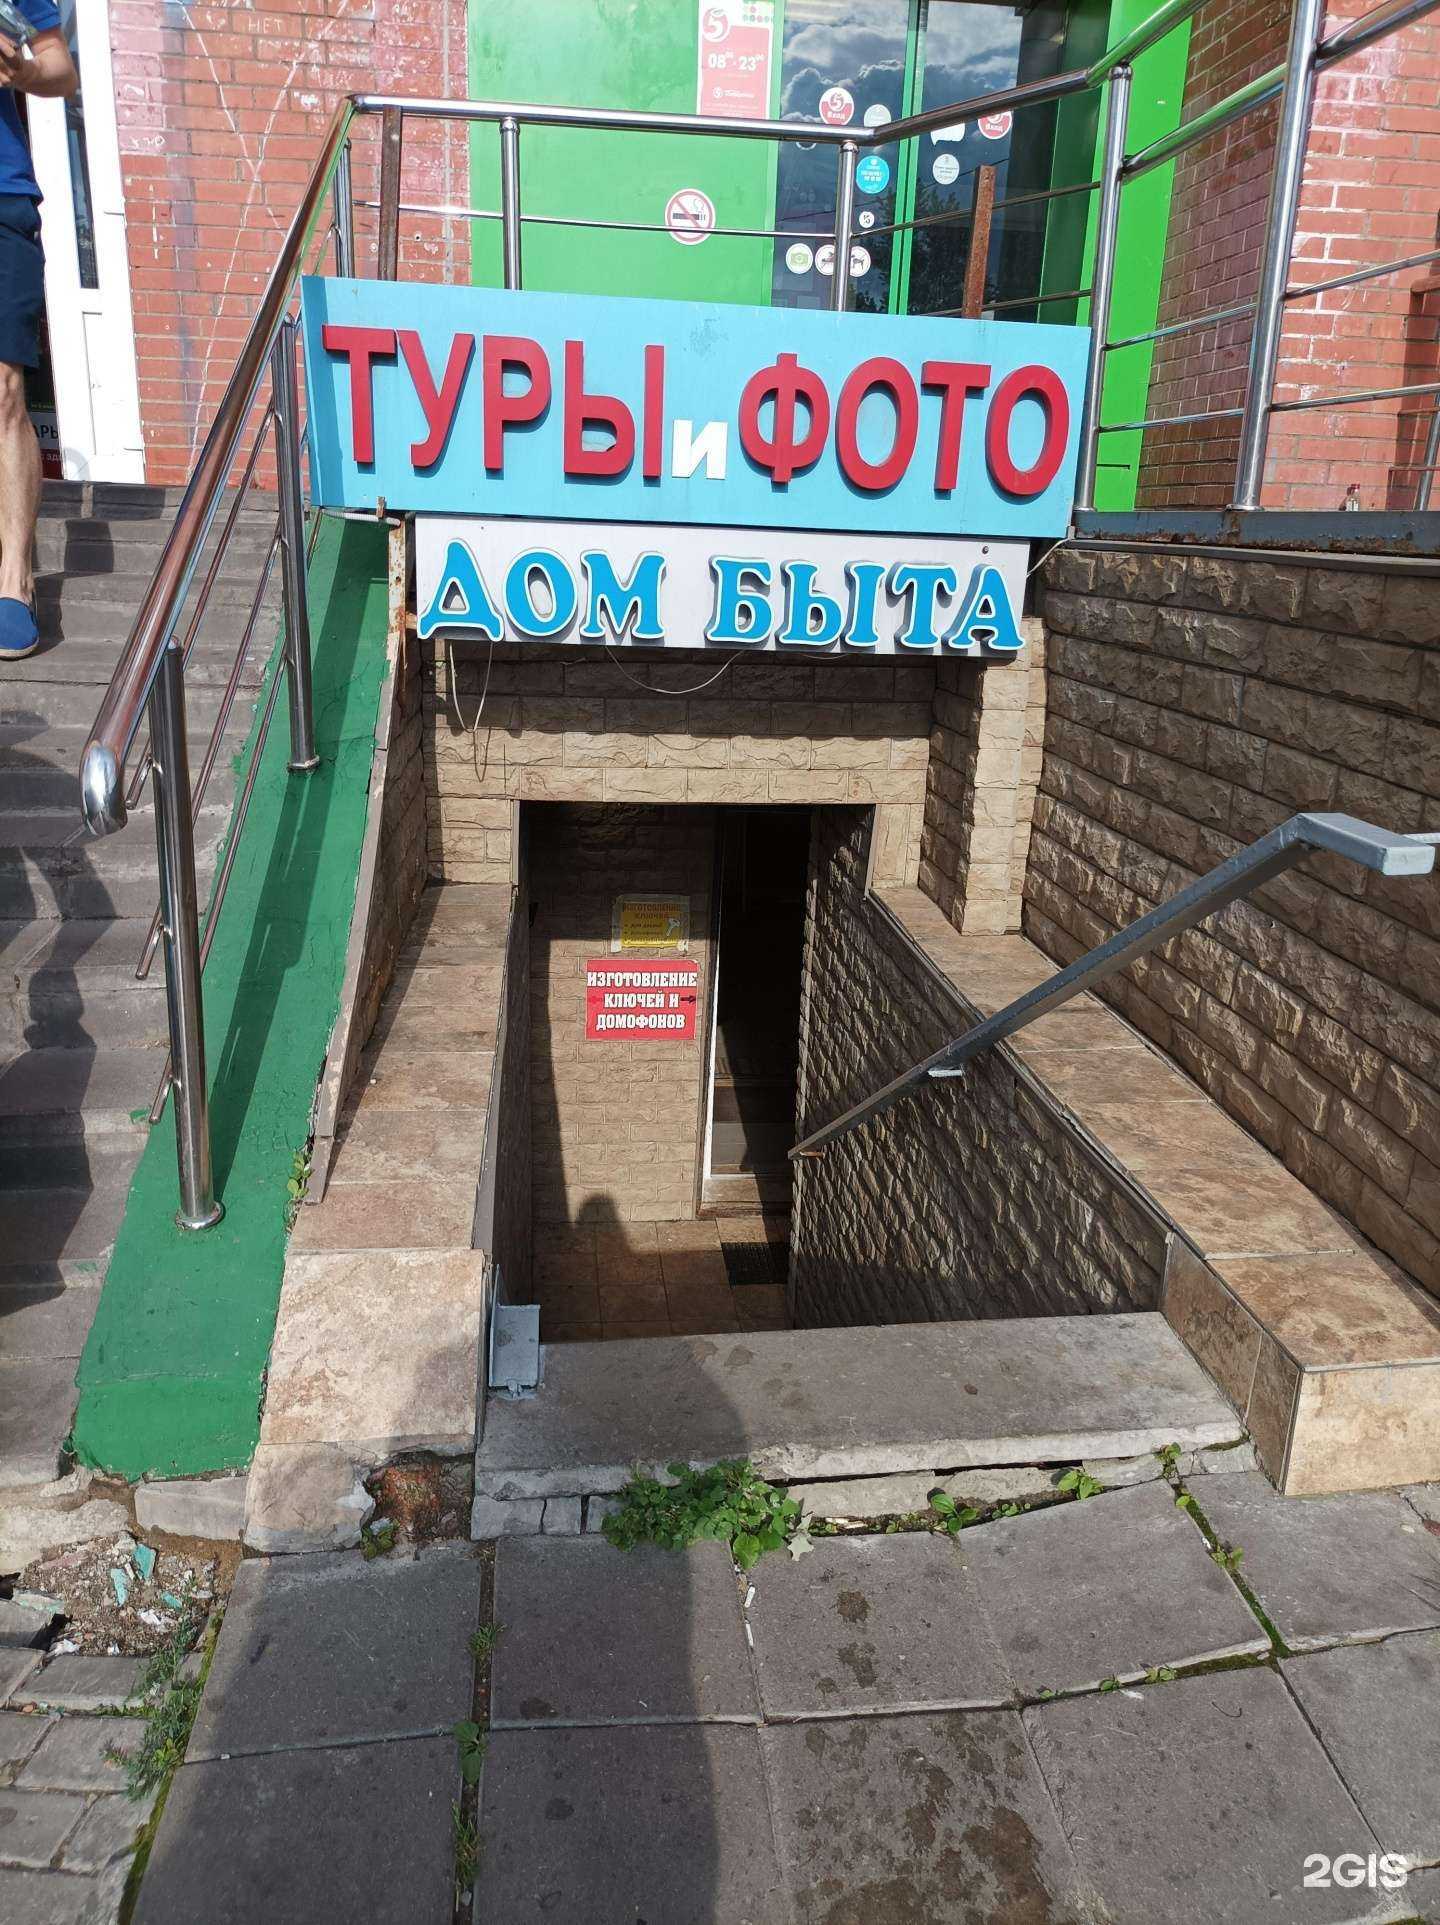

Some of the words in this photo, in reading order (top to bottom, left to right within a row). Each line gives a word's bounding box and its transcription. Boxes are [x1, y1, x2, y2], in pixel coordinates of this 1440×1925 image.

[322, 324, 665, 479] ТУРЫ
[738, 352, 1070, 497] ФОТО
[416, 538, 666, 642] ДОМ
[706, 555, 1026, 651] БЫТА
[587, 972, 697, 987] ИЗГОТОВЛЕНИЕ
[604, 990, 665, 1008] КЛЮЧЕЙ
[669, 993, 680, 1008] И
[596, 1014, 685, 1031] ДОМОФОНОВ
